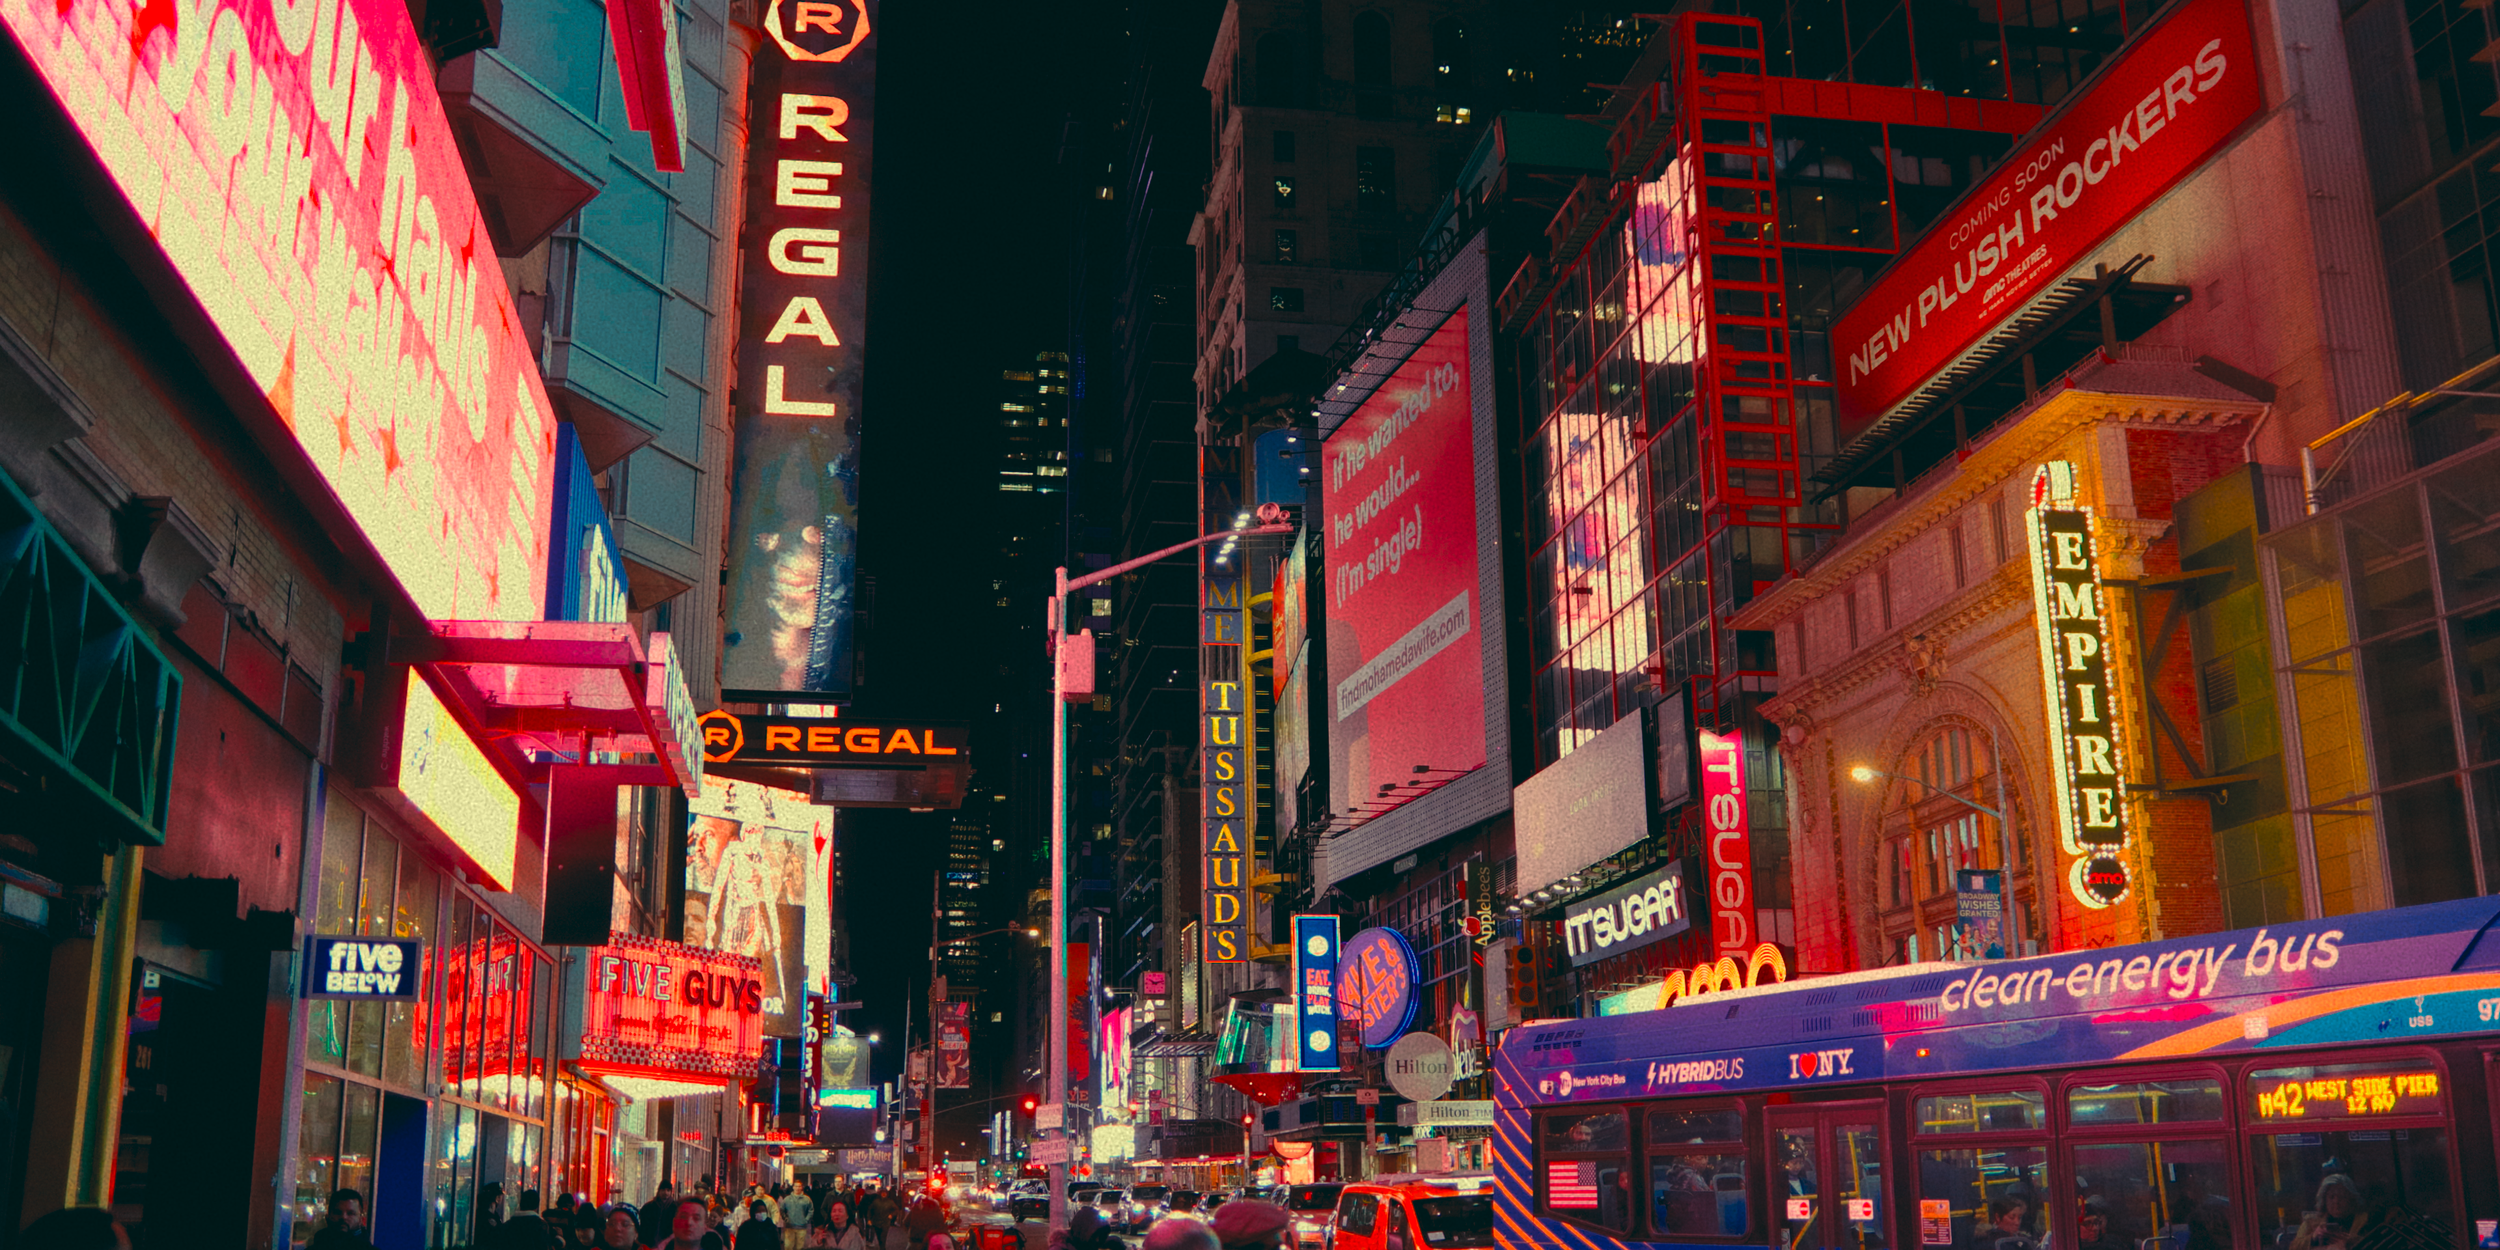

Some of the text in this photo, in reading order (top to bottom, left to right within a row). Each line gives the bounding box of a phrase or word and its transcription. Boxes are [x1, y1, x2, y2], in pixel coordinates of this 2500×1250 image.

[1849, 39, 2227, 387] NEW PLUSH ROCKERS
[1948, 137, 2065, 251] COMING SOON
[378, 75, 491, 442] hauls
[765, 93, 849, 417] REGAL
[2005, 244, 2047, 284] THEATRES
[1333, 362, 1459, 493] If he wanted to,
[1334, 456, 1420, 549] he would...
[1336, 504, 1422, 609] (I'm single)
[1341, 608, 1465, 711] findmohamedawife.com
[2051, 532, 2118, 829] EMPIRE
[766, 724, 957, 755] REGAL
[1211, 682, 1240, 960] TUSSAUD'S
[1475, 866, 1496, 946] Applebee's
[1565, 875, 1681, 958] IT'SUGAR
[1958, 892, 2000, 900] BROADWAY
[1959, 900, 2000, 910] WISHES
[329, 942, 404, 973] five
[1378, 938, 1401, 967] &
[1941, 928, 2345, 1012] clean-energy bus
[601, 956, 763, 1014] FIVE GUYS
[2409, 1015, 2434, 1027] USB
[1395, 1059, 1448, 1074] Hilton
[1573, 1074, 1626, 1087] New York City Bus
[1790, 1053, 1799, 1078] I
[2305, 1072, 2438, 1101] WEST SIDE PIER
[1430, 1106, 1469, 1118] Hilton
[2258, 1082, 2304, 1117] M42
[2347, 1094, 2395, 1114] 12 AV
